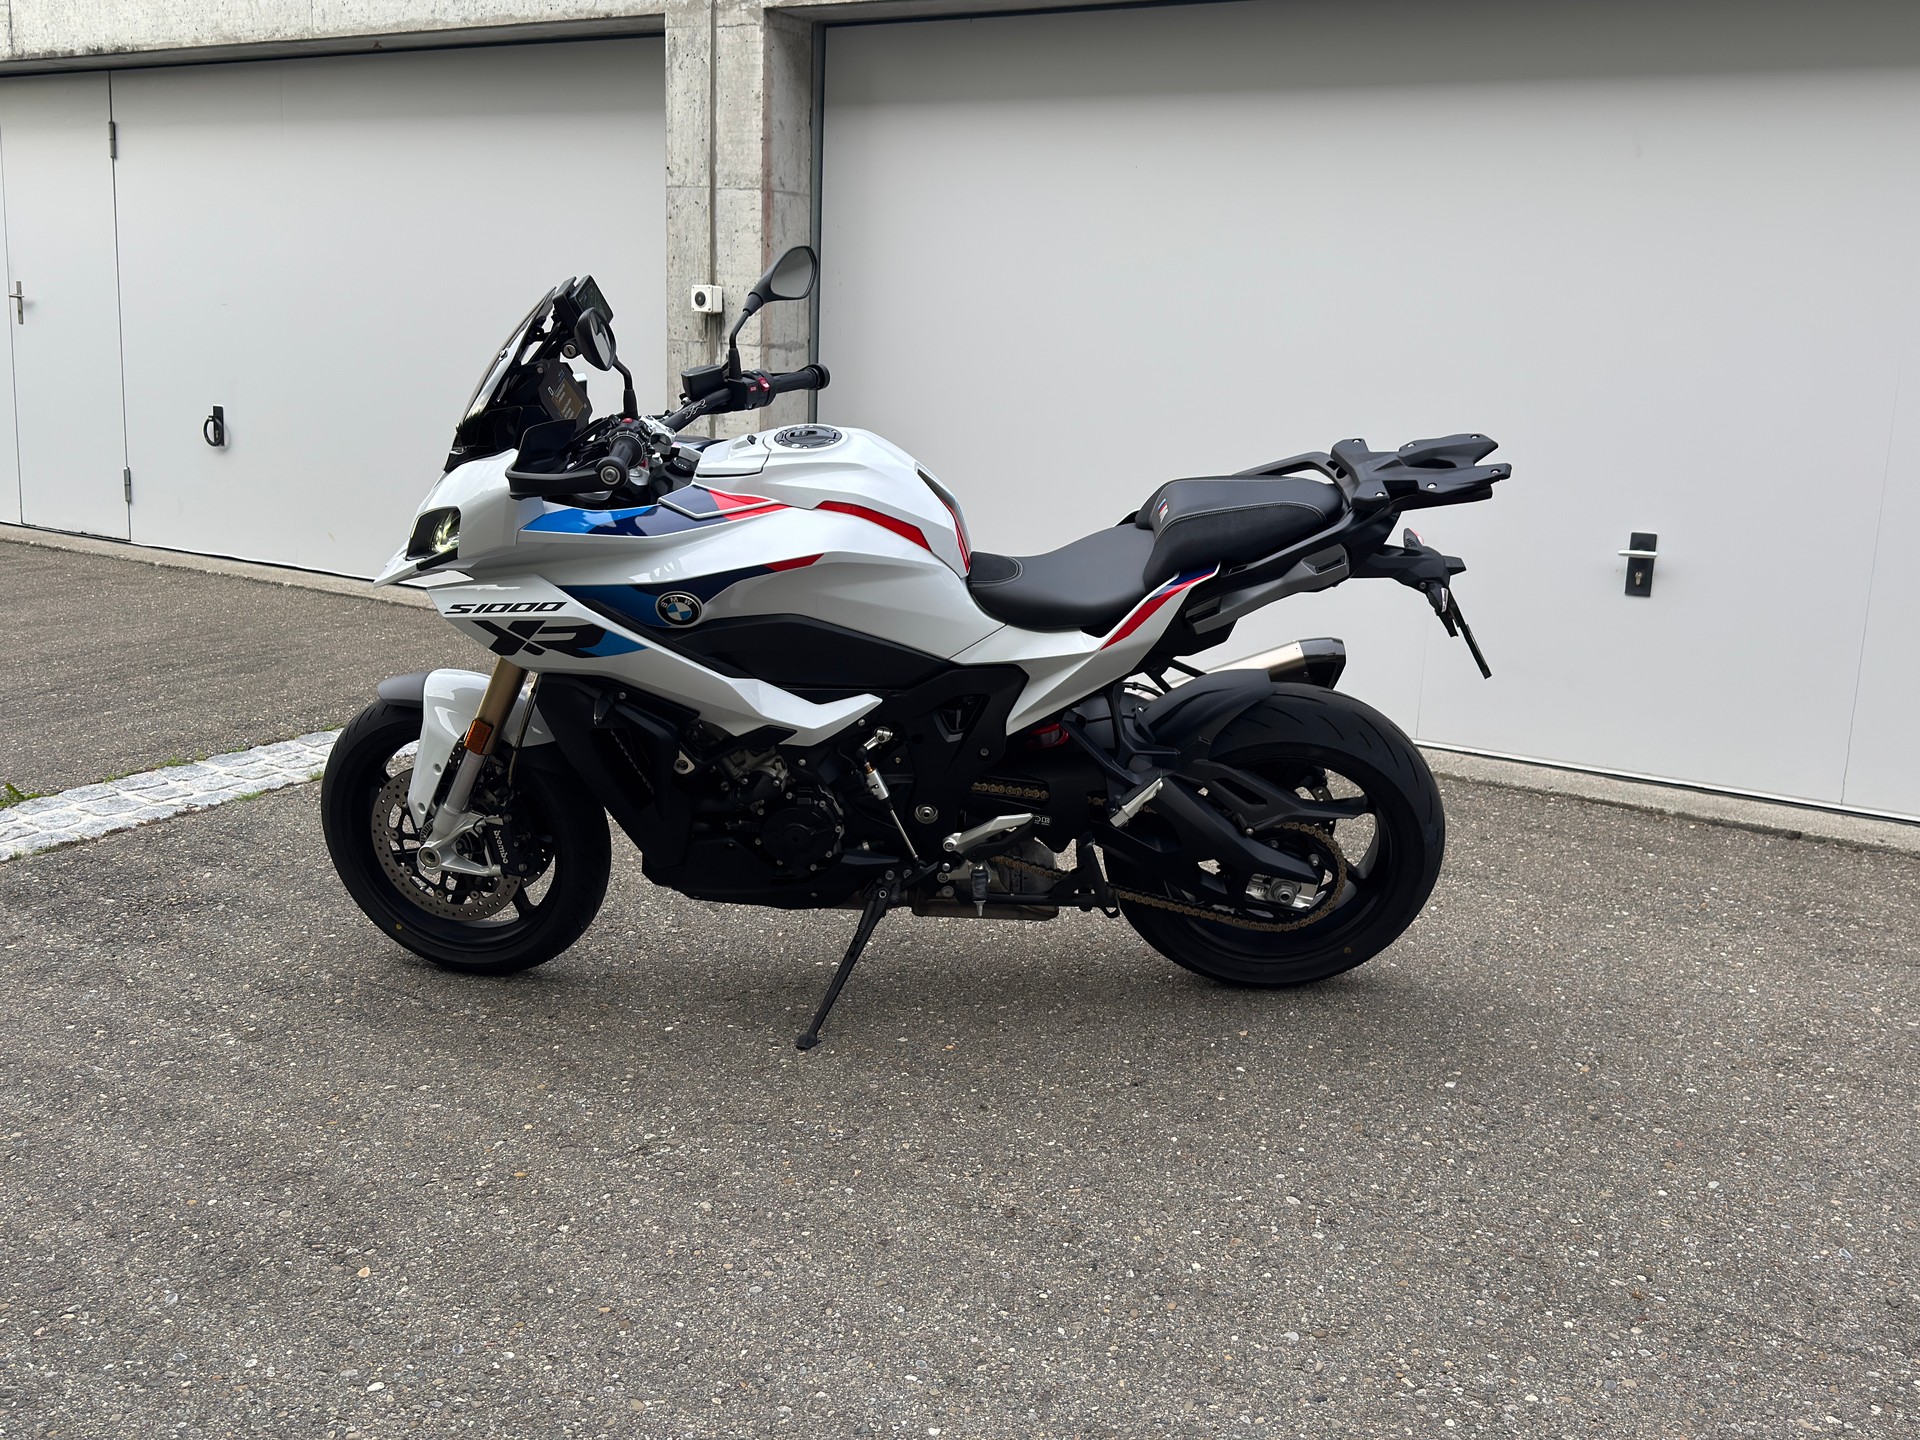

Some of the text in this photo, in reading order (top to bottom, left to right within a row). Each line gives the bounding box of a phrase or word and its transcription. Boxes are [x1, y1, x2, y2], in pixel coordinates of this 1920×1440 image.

[444, 601, 568, 615] S1000
[660, 596, 693, 609] BMW
[470, 619, 608, 659] XR
[493, 829, 509, 864] brembo
